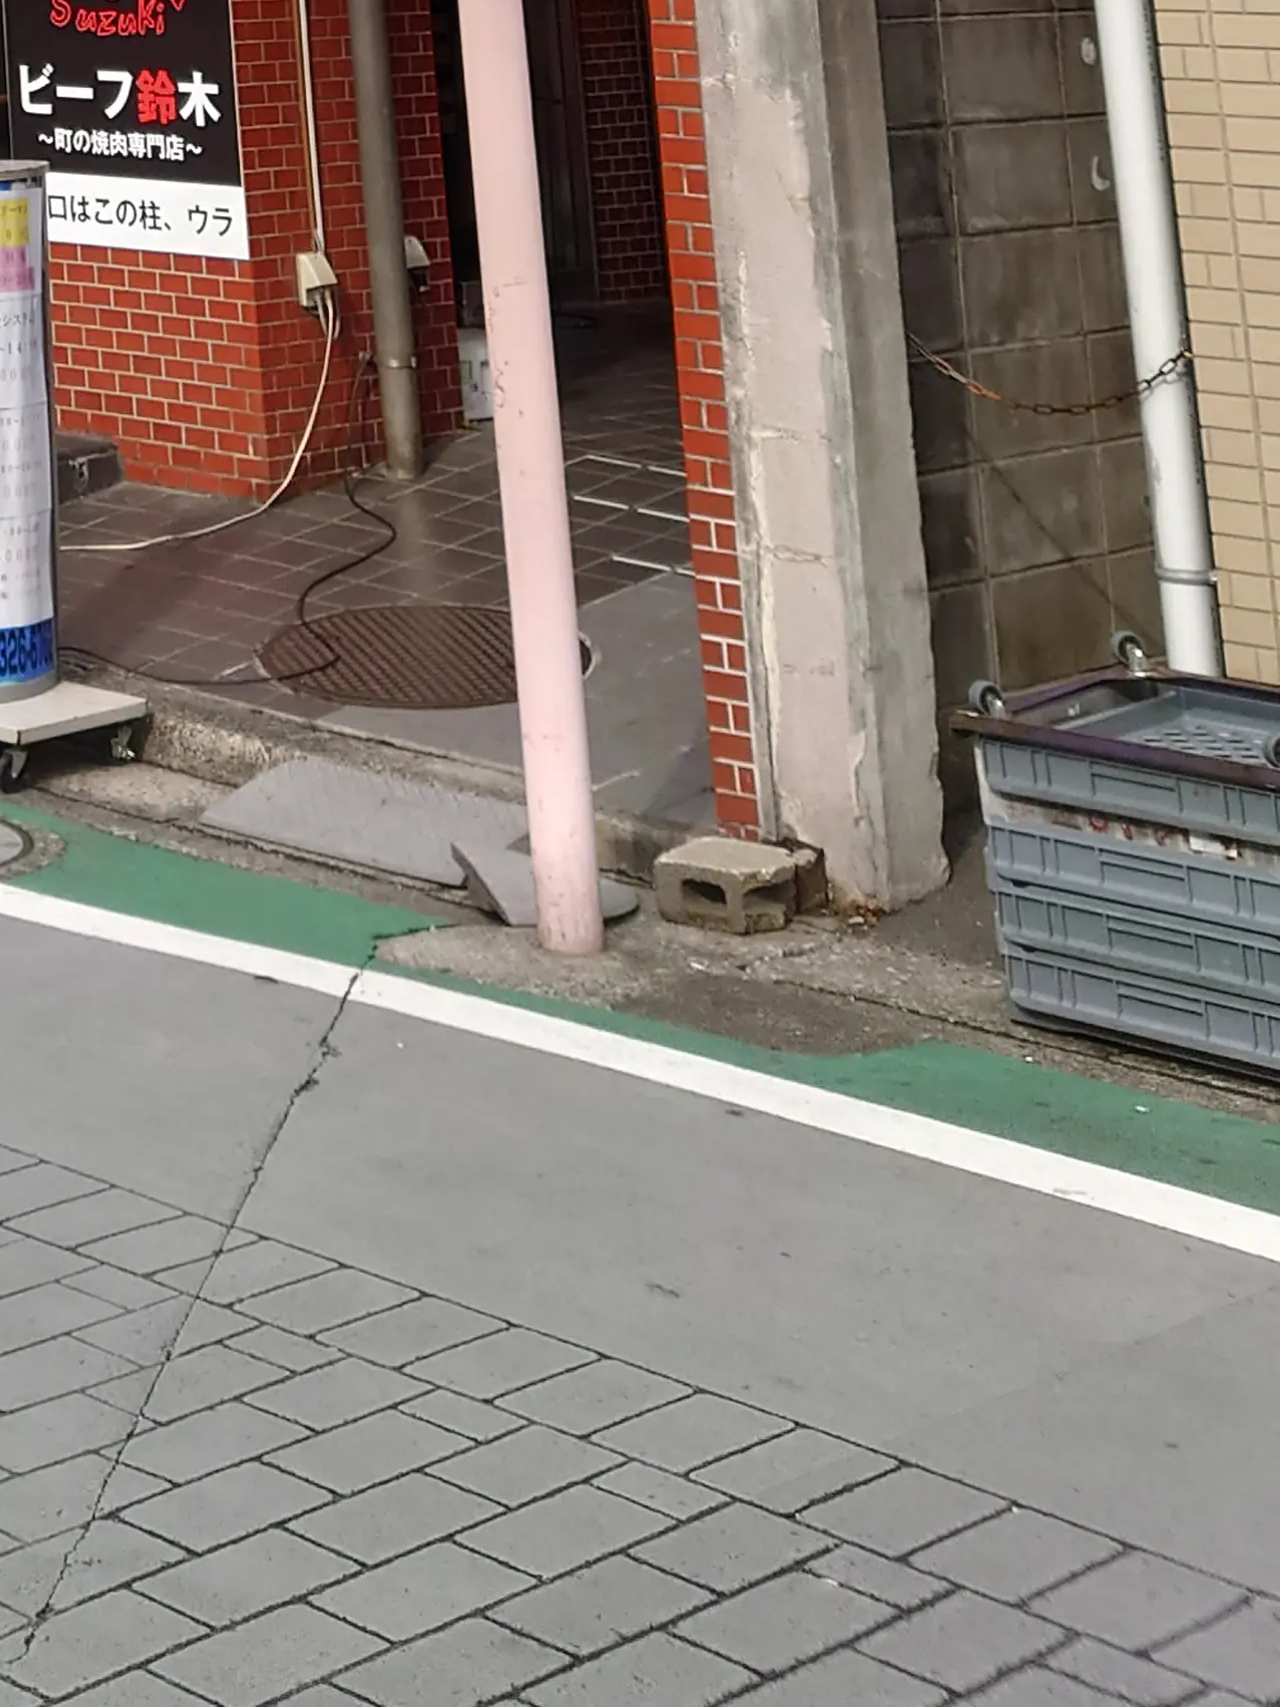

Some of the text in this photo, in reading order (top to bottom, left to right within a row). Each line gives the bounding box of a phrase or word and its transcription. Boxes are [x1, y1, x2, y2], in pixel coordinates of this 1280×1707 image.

[18, 63, 222, 127] ビーフ鈴木
